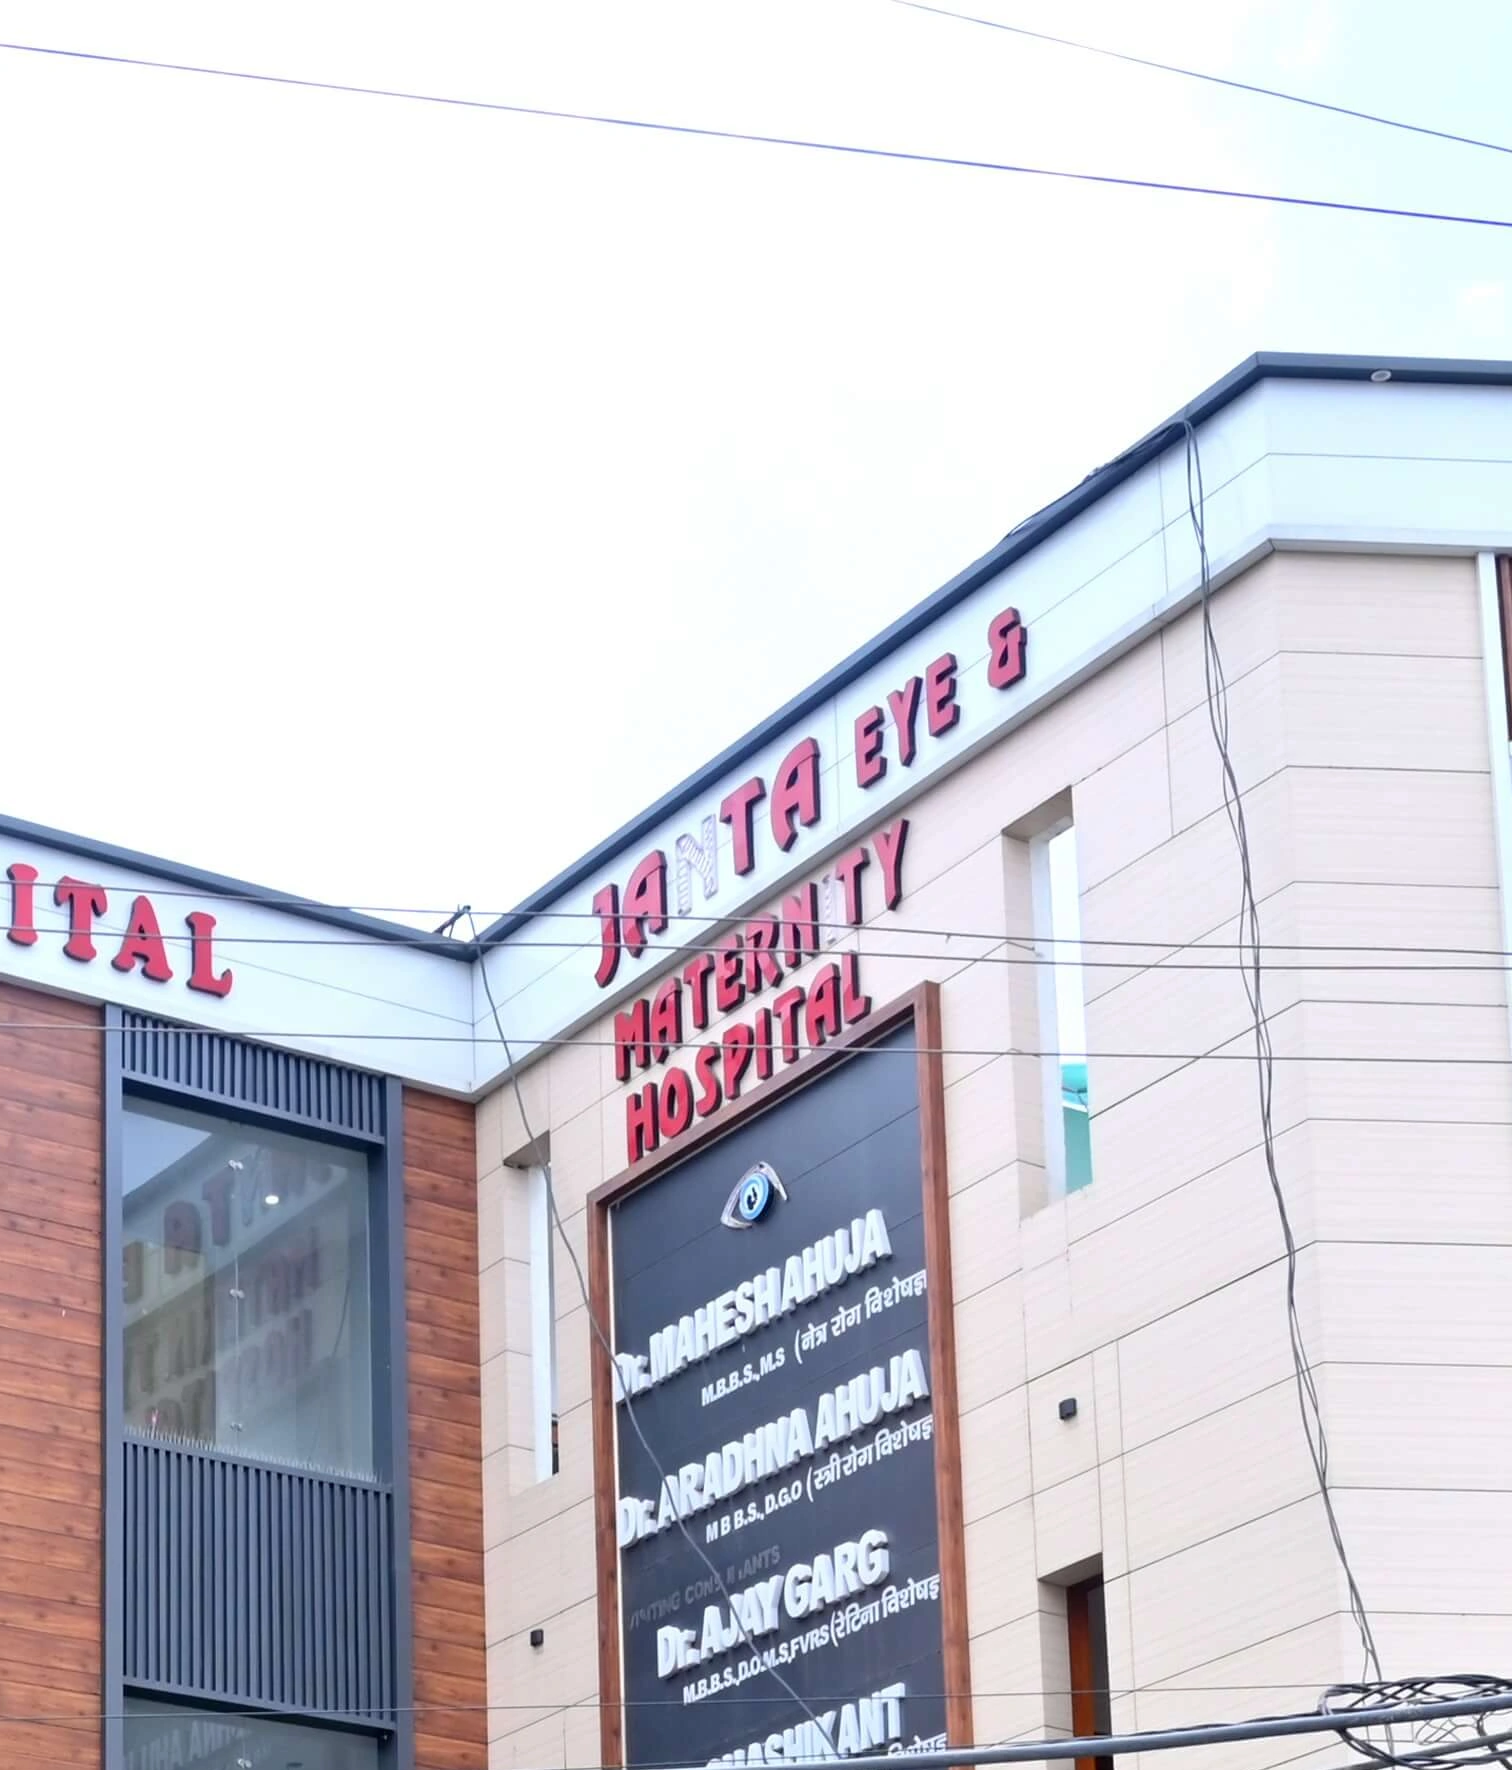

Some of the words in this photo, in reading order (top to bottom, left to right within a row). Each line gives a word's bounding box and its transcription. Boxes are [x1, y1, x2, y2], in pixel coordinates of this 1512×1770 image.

[592, 737, 821, 988] JANTA
[855, 652, 960, 788] EYE
[987, 607, 1027, 689] &
[614, 819, 910, 1081] MATERNITY
[626, 952, 871, 1163] HOSPITAL
[781, 1208, 893, 1315] AHUJA
[783, 1528, 891, 1618] GARG
